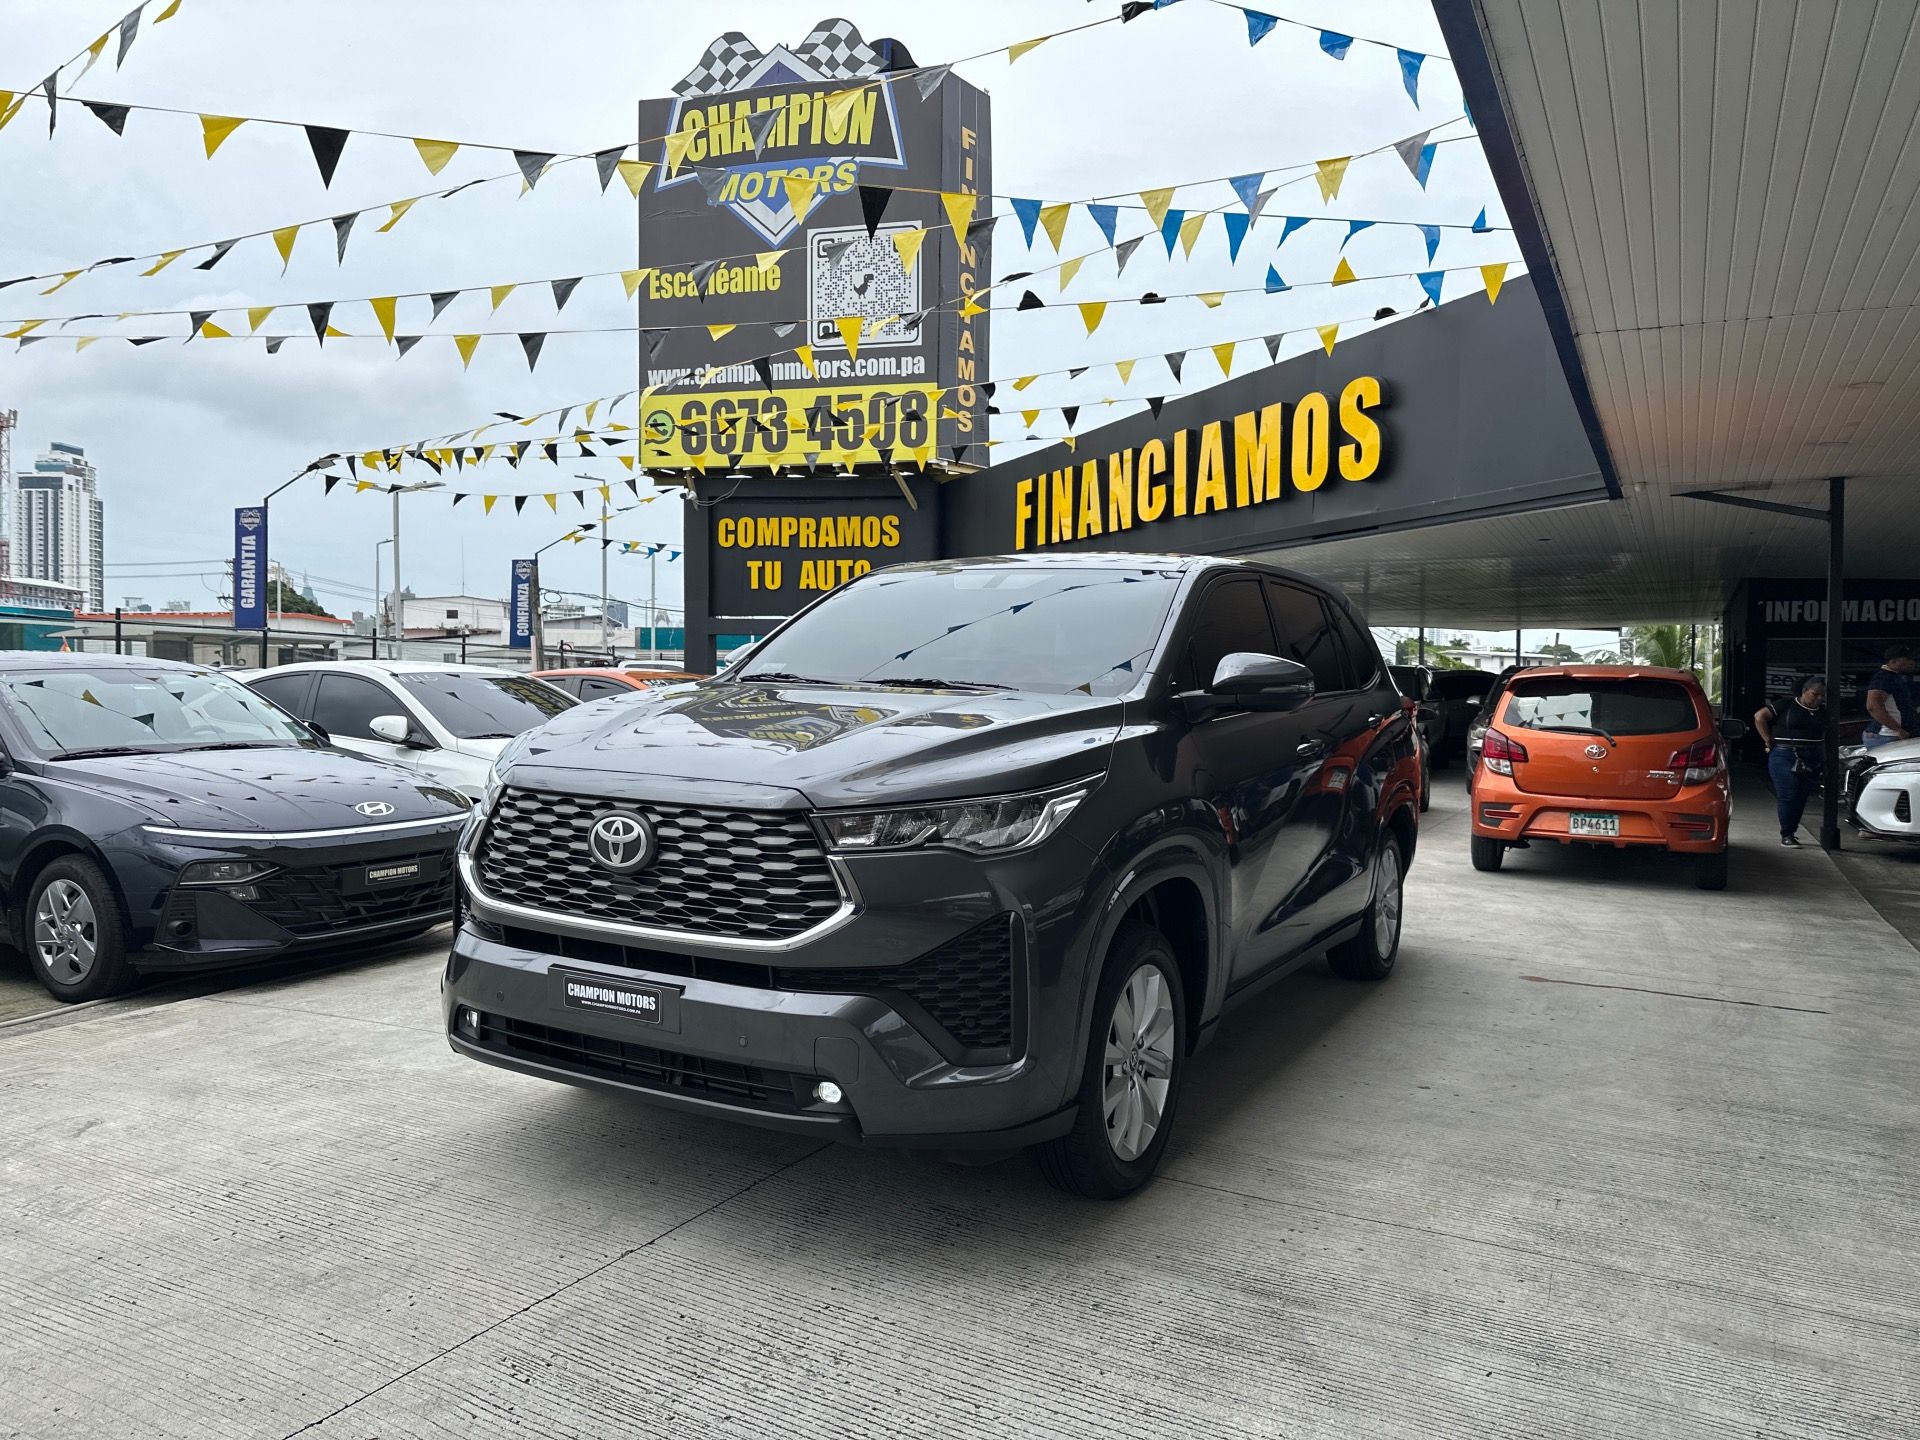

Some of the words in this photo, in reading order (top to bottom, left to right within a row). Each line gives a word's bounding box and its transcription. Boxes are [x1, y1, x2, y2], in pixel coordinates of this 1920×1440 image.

[957, 126, 977, 433] FINCAMOS
[647, 355, 926, 387] www.champnmotors.com.pa
[1015, 376, 1381, 550] FINANCIAMOS
[718, 515, 900, 548] COMPRAMOS
[240, 534, 257, 609] GARANTIA
[746, 560, 782, 590] TU
[516, 583, 530, 636] CONFIANZA
[1572, 817, 1616, 831] BP4611
[369, 867, 397, 879] CHAMPION
[397, 864, 418, 875] MOTORS
[567, 982, 616, 1003] CHAMPION
[616, 990, 656, 1010] MOTORS
